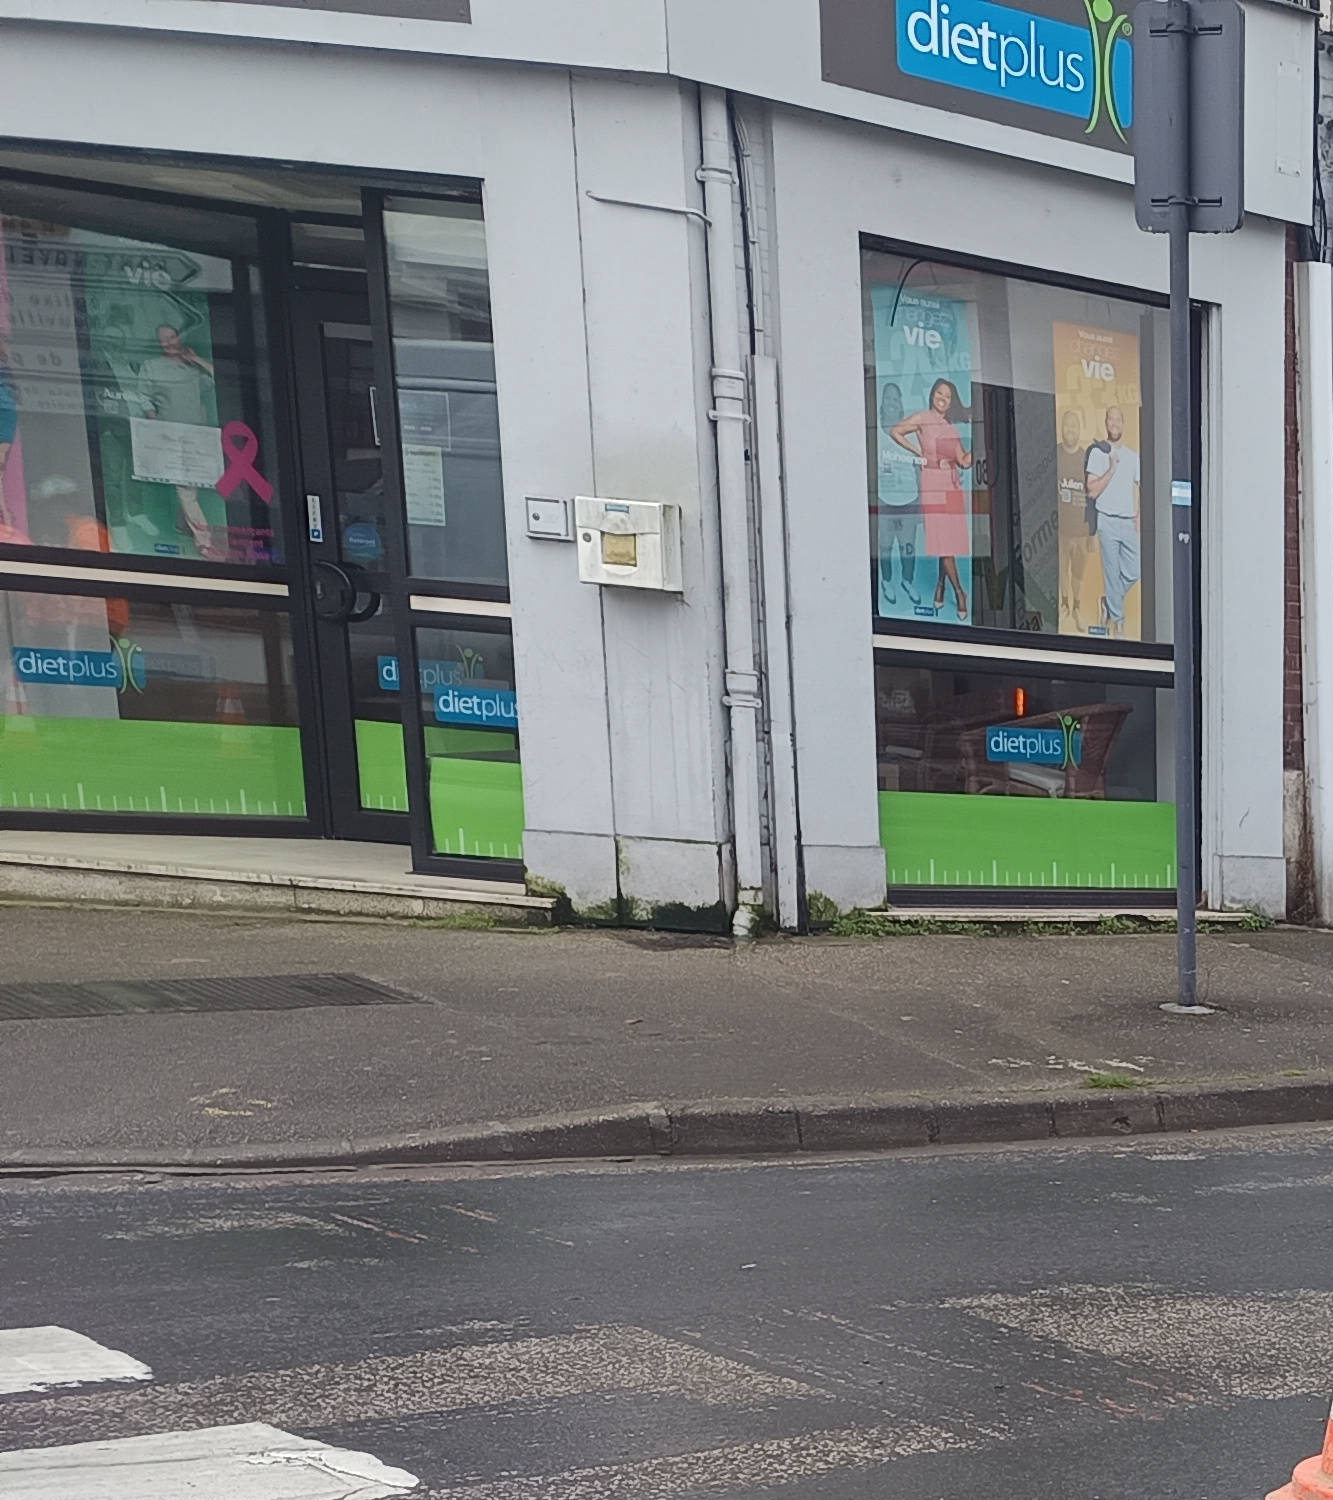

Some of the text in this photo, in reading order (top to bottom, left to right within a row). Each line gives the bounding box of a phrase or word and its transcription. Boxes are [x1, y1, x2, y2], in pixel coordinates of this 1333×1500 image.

[907, 0, 1085, 92] dietplus
[903, 321, 942, 350] vie
[1080, 355, 1115, 382] vie
[18, 653, 118, 681] dietplus
[990, 731, 1062, 758] dietplus
